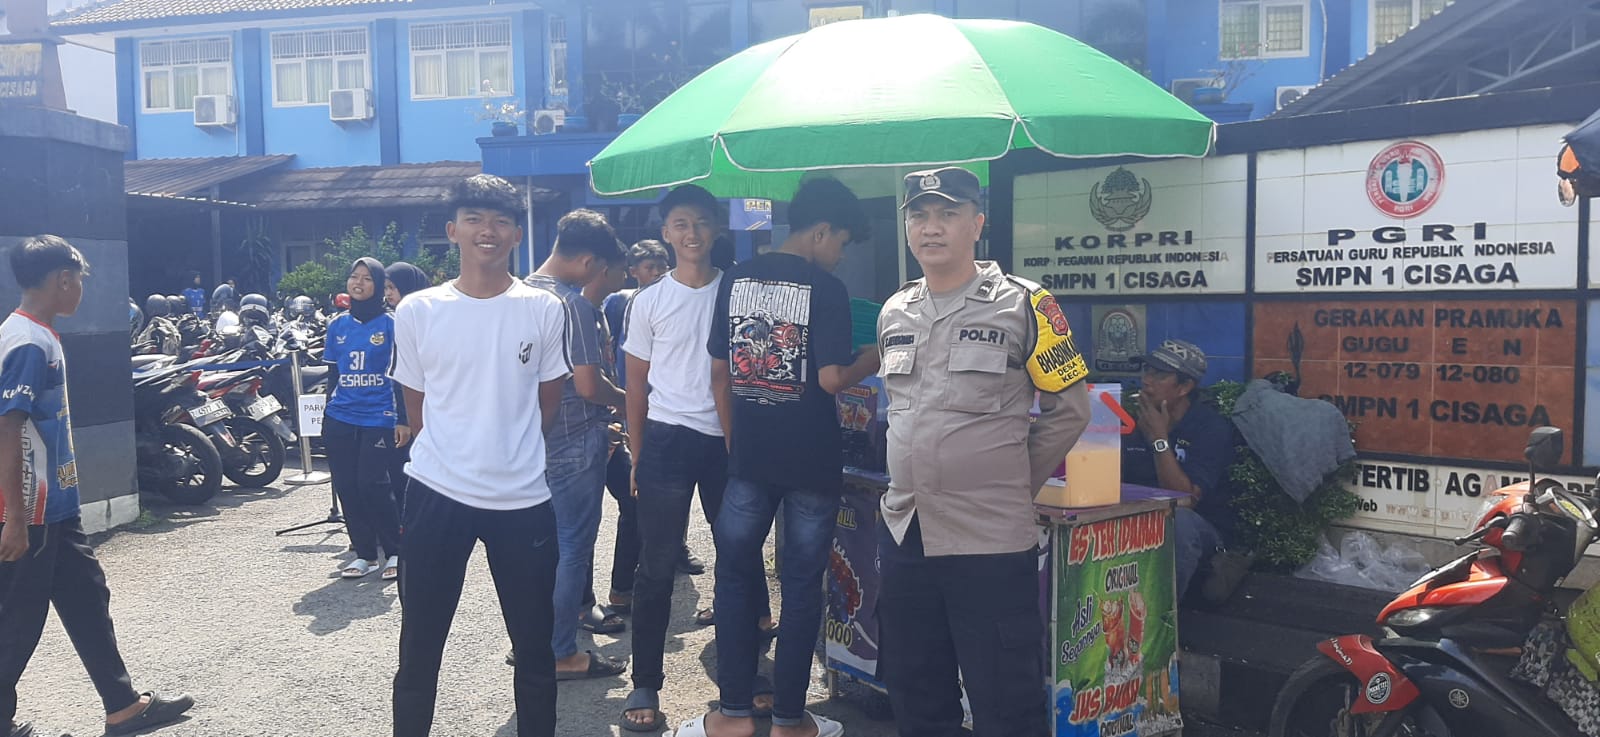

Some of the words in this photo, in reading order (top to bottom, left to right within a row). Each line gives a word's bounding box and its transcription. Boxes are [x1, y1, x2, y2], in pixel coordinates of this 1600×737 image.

[1055, 230, 1193, 250] KORPRI
[1327, 222, 1487, 246] PGRI
[1057, 254, 1104, 266] PEGAWAI
[1106, 252, 1162, 264] REPUBLIK
[1165, 251, 1229, 263] INDONESIA
[1266, 249, 1344, 263] PERSATUAN
[1348, 248, 1388, 260] GURU
[1392, 245, 1464, 259] REPUBLIK
[1041, 272, 1097, 290] SMPN
[1105, 273, 1116, 289] 1
[1123, 270, 1208, 289] CISAGA
[1295, 266, 1373, 286] SMPN
[1382, 266, 1394, 285] 1
[1404, 262, 1520, 285] CISAGA
[1314, 308, 1424, 328] GERAKAN
[1434, 308, 1563, 329] PRAMUKA
[959, 329, 1006, 344] POLRI
[1342, 336, 1410, 353] GUGU
[349, 351, 365, 370] 31
[1057, 361, 1078, 376] DESA
[1343, 362, 1421, 380] 12-079
[1436, 364, 1521, 384] 12-080
[1318, 394, 1397, 419] MPN
[1406, 398, 1420, 420] 1
[1429, 400, 1551, 426] CISAGA
[1352, 463, 1430, 492] TERTIB
[1067, 524, 1090, 565] ES
[1091, 519, 1117, 561] TEH
[1105, 561, 1139, 593] ORIGINAL
[1071, 595, 1094, 638] Asli
[1068, 686, 1101, 725] JUS
